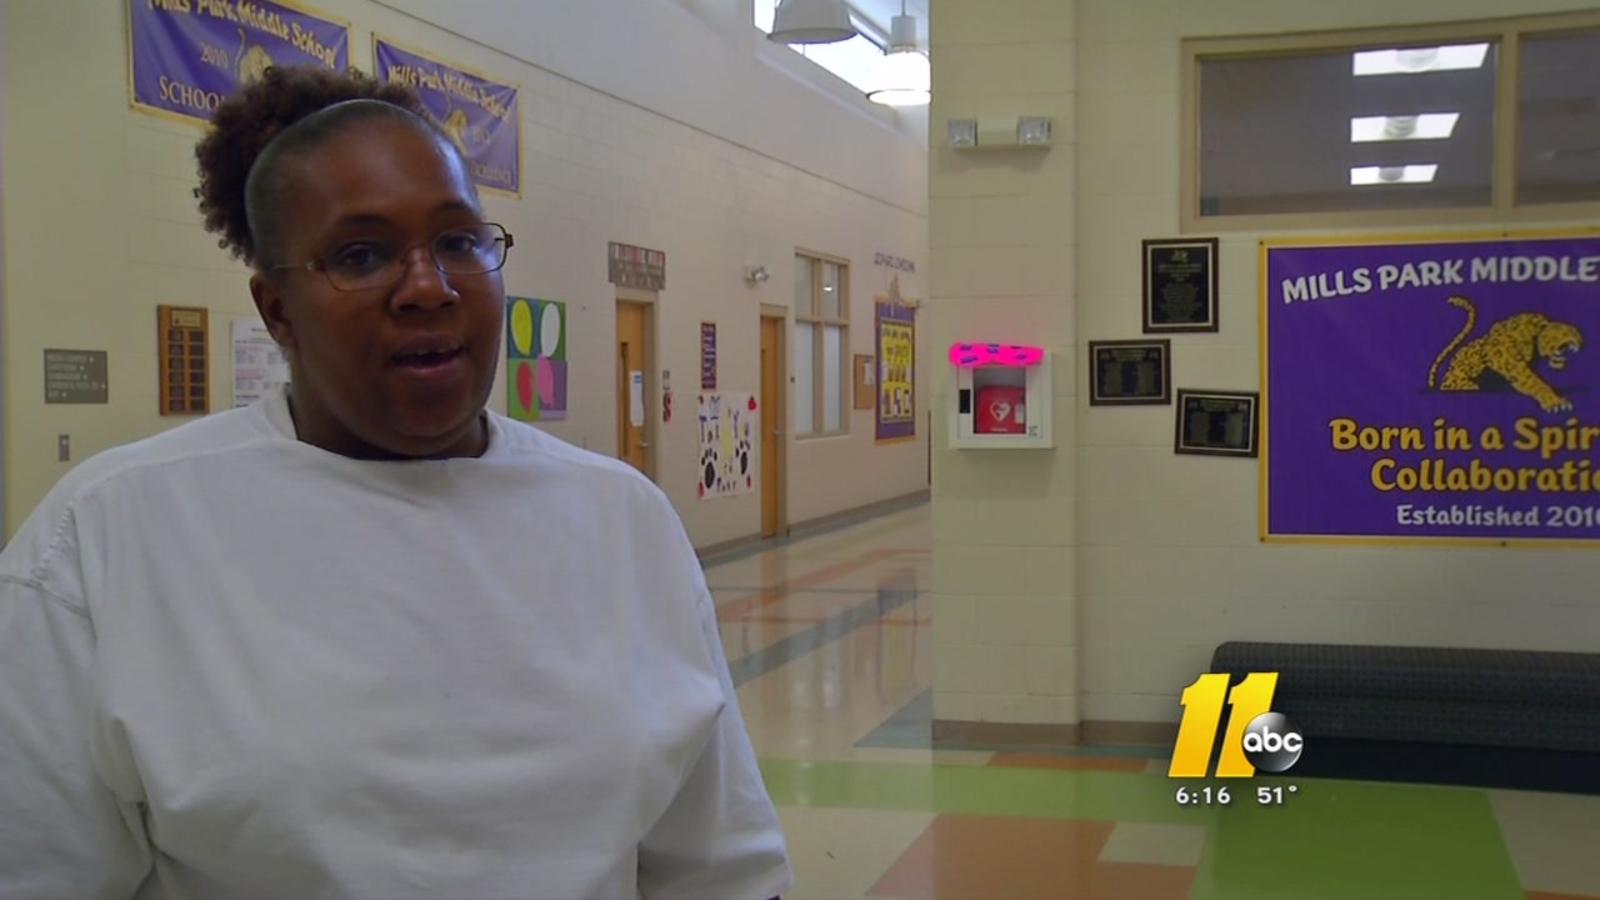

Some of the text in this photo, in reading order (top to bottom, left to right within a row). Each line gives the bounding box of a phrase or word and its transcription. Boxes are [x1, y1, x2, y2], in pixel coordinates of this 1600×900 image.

[237, 1, 290, 41] Middle
[291, 22, 338, 69] School
[200, 43, 229, 69] 2010
[159, 75, 225, 111] SCHOO
[1282, 257, 1600, 304] MILLS PARK MIDDLE
[1329, 418, 1600, 459] Born in a Spir
[1396, 504, 1540, 527] Established
